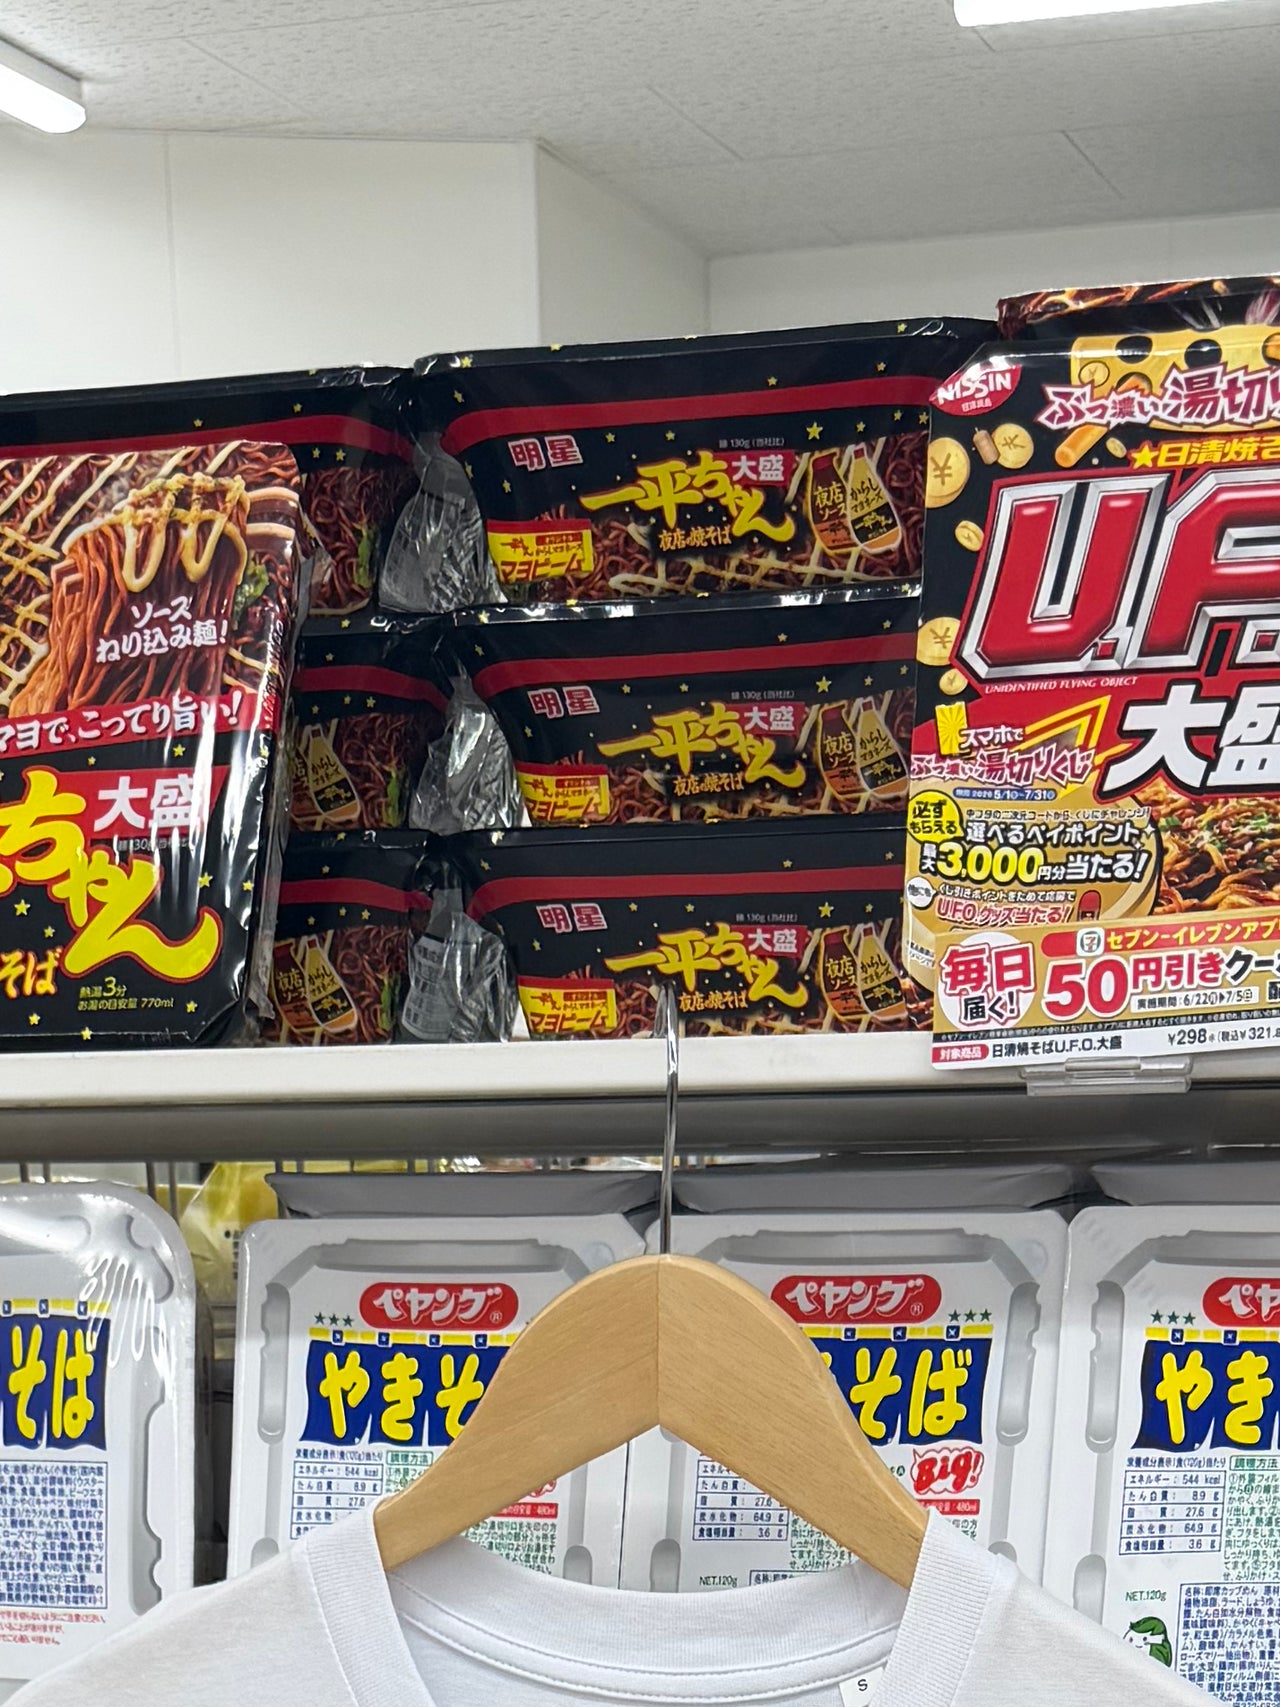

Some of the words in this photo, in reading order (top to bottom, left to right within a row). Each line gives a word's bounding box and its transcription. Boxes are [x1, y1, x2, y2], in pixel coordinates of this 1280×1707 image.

[935, 371, 1013, 405] NISSIN
[509, 435, 582, 470] 明星
[731, 454, 786, 484] 大盛
[580, 450, 794, 544] 一平ちゃん
[131, 596, 192, 626] ソース
[96, 620, 230, 664] ねり込み麺!
[984, 678, 1057, 695] UNIDENTIFIED
[1060, 677, 1097, 692] FLYING
[1099, 674, 1138, 688] OBJECT
[598, 702, 805, 789] 一平ちゃん
[93, 777, 207, 831] 大盛
[912, 800, 947, 819] 必ず
[909, 821, 958, 835] もらえる
[966, 821, 1140, 847] 選べるペイポイント
[537, 902, 608, 932] 明星
[606, 922, 808, 1008] 一平ちゃん
[943, 945, 1033, 993] 毎日
[371, 1286, 501, 1323] ペヤング
[785, 1278, 914, 1319] ペヤング
[913, 1451, 982, 1494] Big!
[1184, 1522, 1204, 1534] 64.9
[1125, 1590, 1167, 1602] NET.120g
[855, 1678, 869, 1693] S
